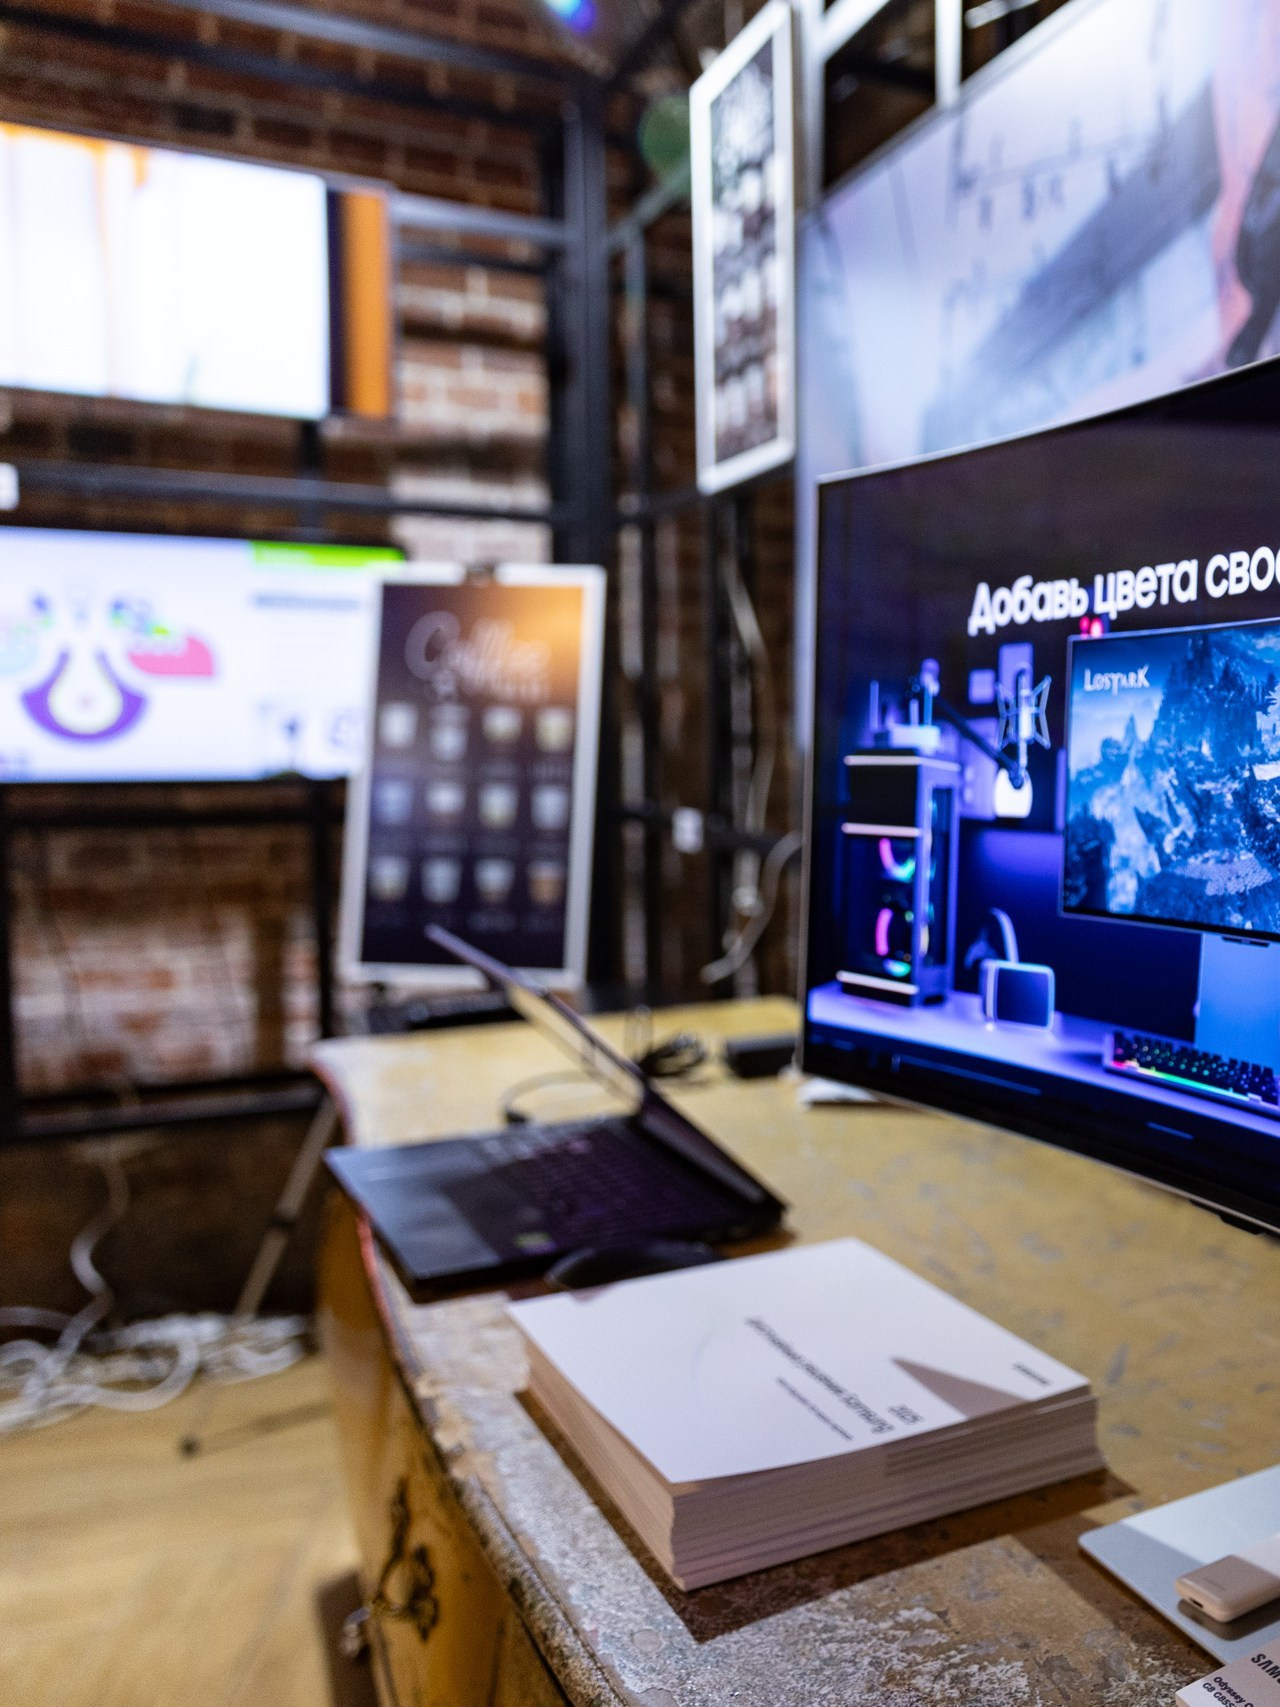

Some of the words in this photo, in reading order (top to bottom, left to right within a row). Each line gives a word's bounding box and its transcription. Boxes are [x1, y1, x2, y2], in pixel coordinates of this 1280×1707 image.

[967, 575, 1089, 637] Добавь
[1094, 558, 1199, 620] цвета
[1202, 1682, 1216, 1693] G8
[1213, 1676, 1247, 1703] Odyssey
